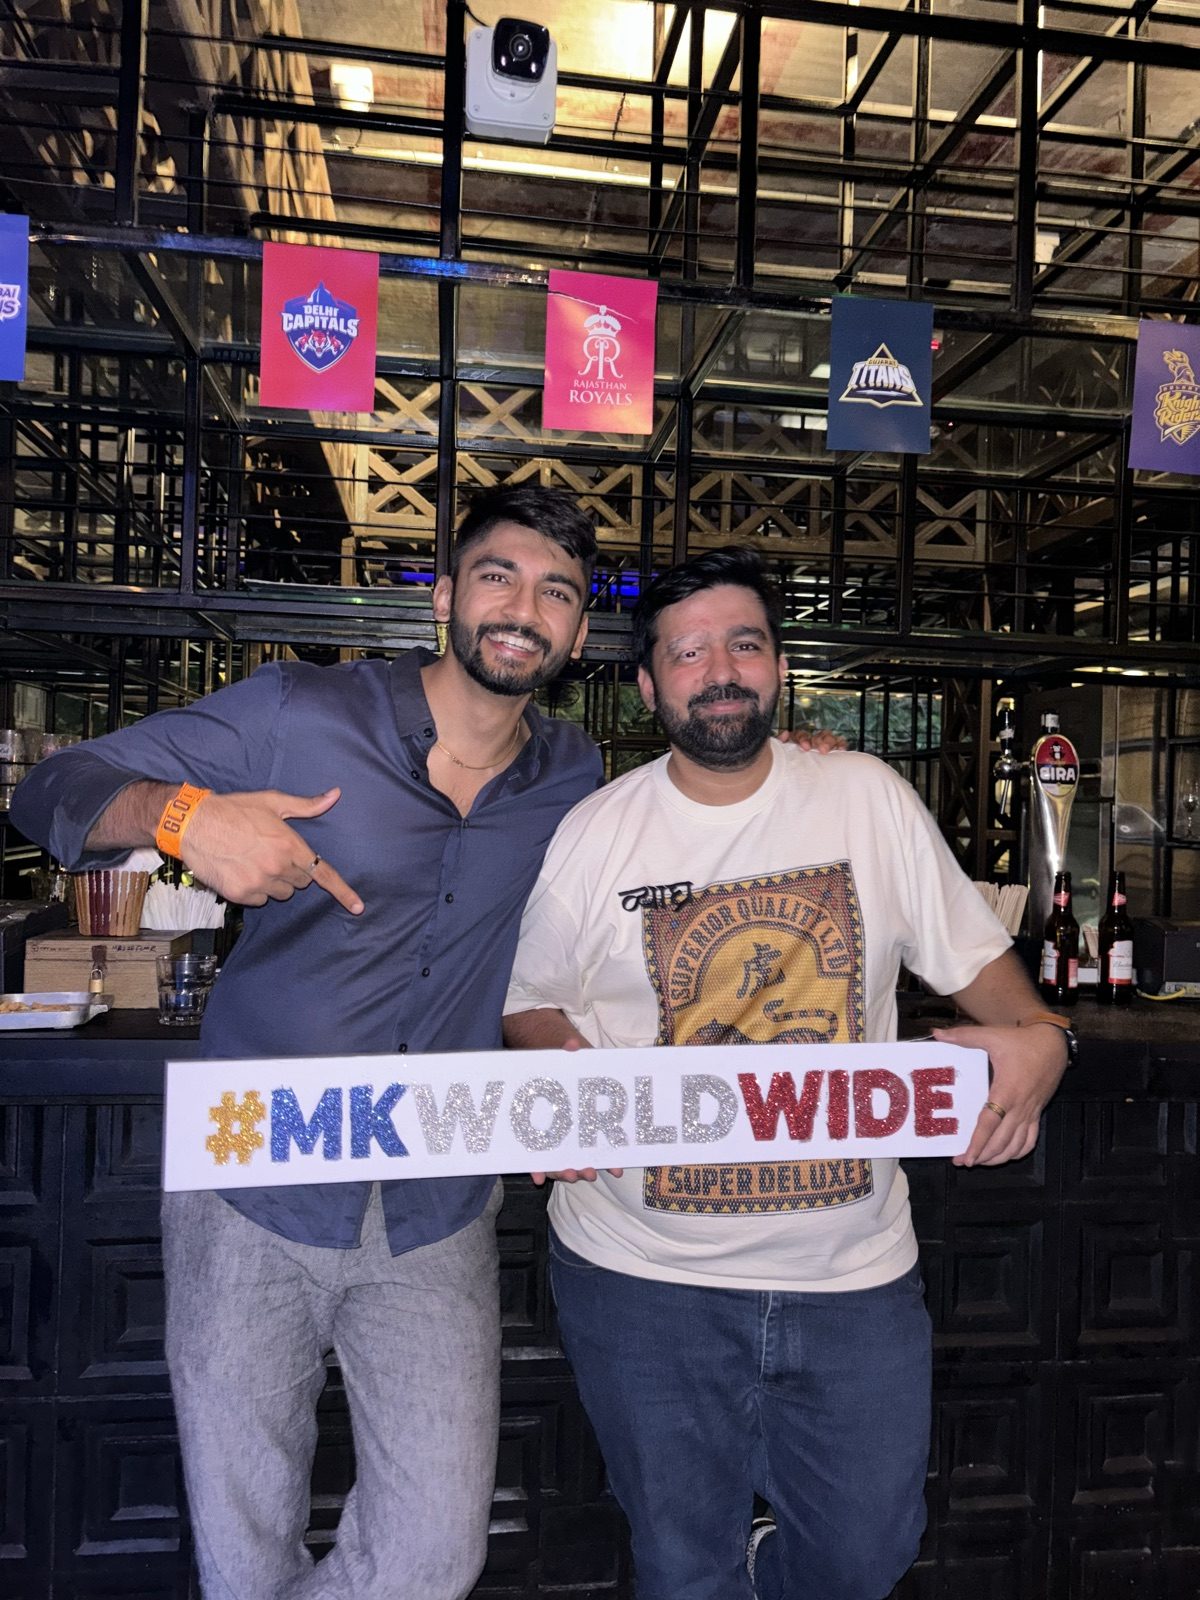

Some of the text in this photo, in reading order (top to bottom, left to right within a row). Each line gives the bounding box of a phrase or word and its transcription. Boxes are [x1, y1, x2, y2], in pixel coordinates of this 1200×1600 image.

[303, 304, 339, 317] DELHI
[281, 312, 360, 338] CAPITALS
[573, 379, 628, 390] RAJASTHAN
[851, 361, 916, 393] TITANS
[569, 389, 633, 406] ROYALS
[1159, 390, 1200, 412] Knigh
[670, 896, 850, 1001] SUPERIOR QUALITY LTD
[205, 1066, 959, 1166] #MKWORLDWIDE
[668, 1158, 856, 1196] SUPER DELUXE
